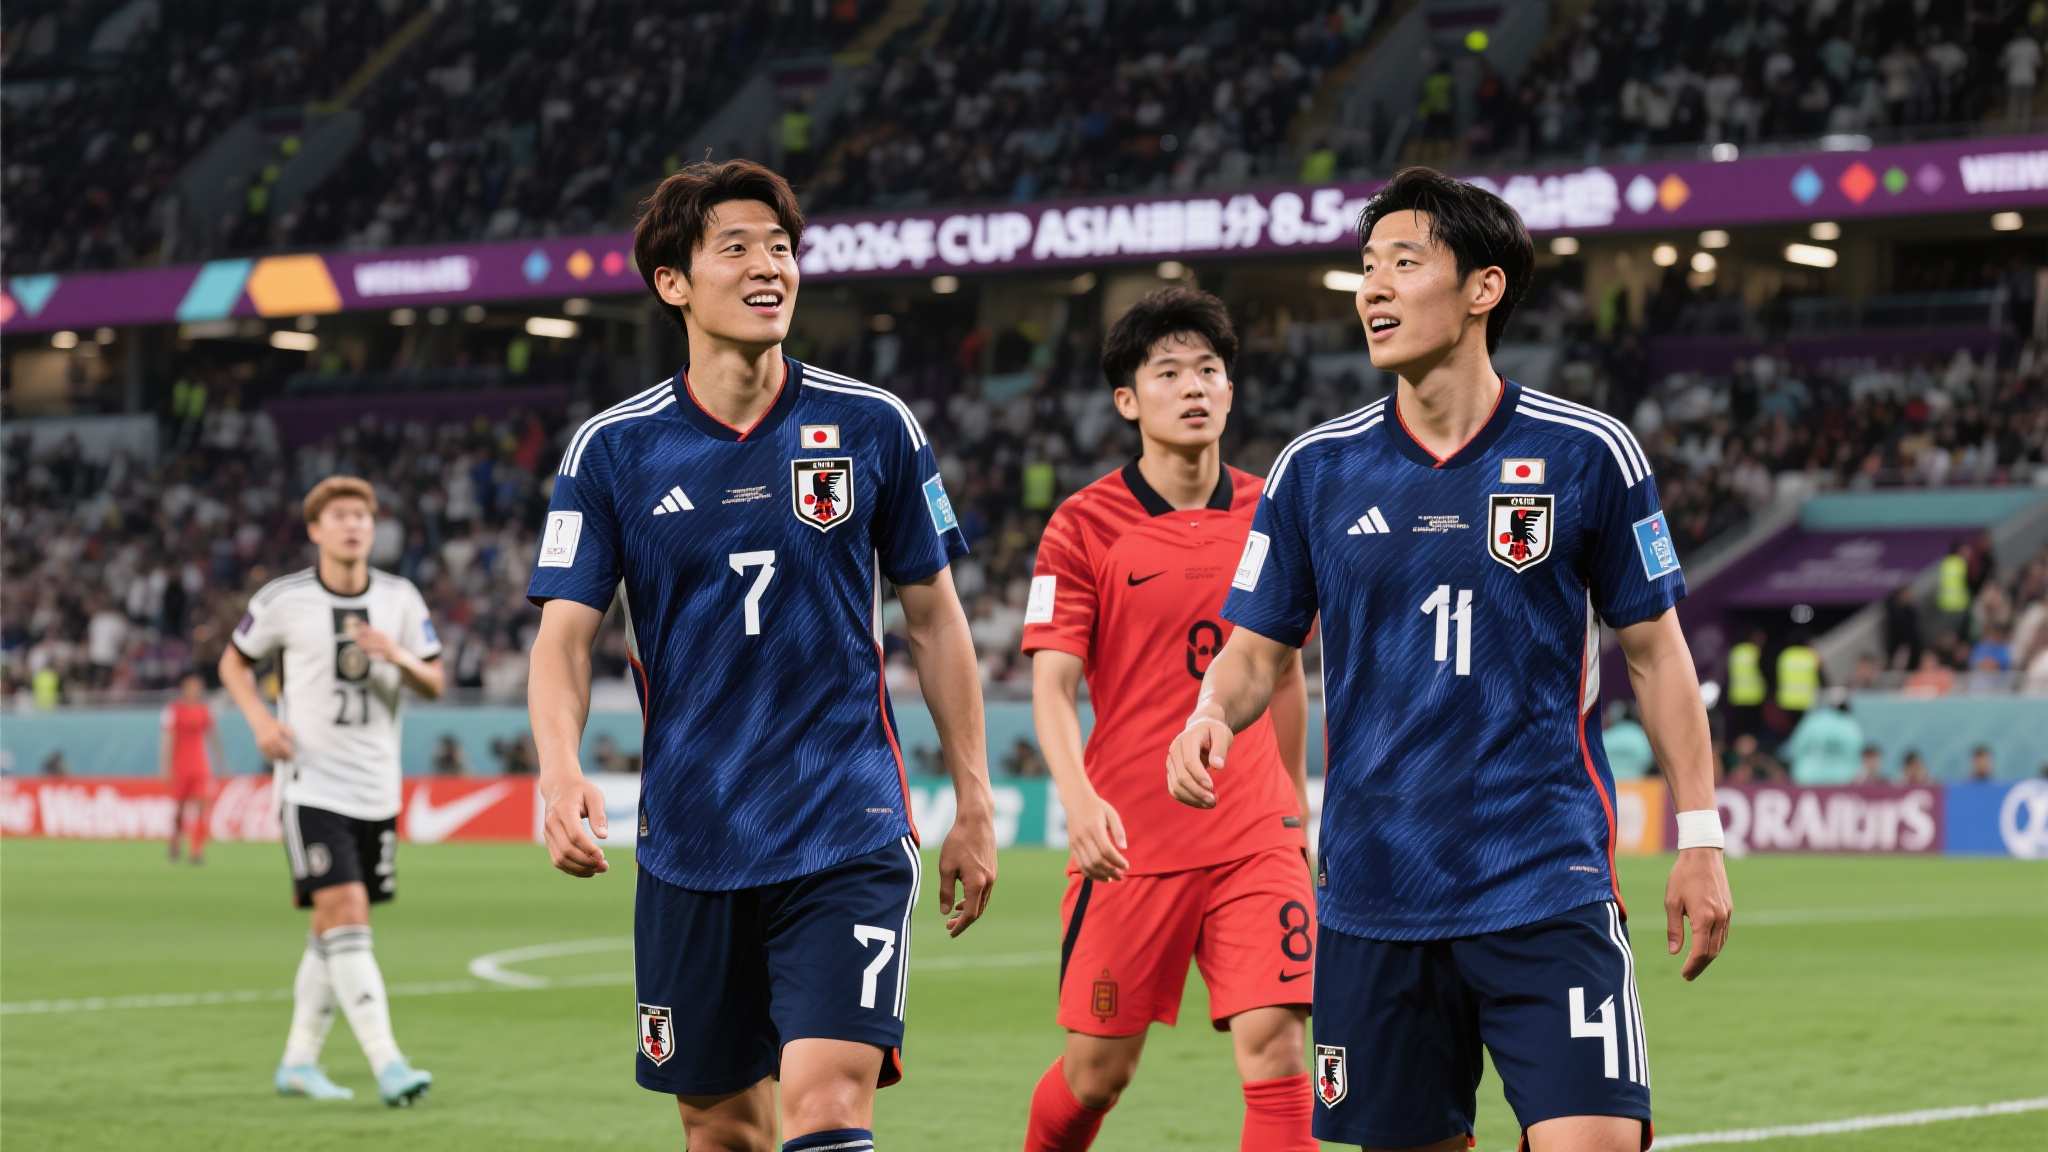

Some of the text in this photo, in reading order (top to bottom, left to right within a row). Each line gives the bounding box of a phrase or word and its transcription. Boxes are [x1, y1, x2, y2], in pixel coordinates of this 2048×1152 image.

[937, 212, 1032, 266] CUP
[729, 550, 775, 635] 7
[1420, 584, 1472, 675] 11
[333, 688, 370, 725] 21
[853, 924, 896, 1009] 7
[1279, 901, 1312, 961] 8
[1569, 986, 1620, 1080] 4
